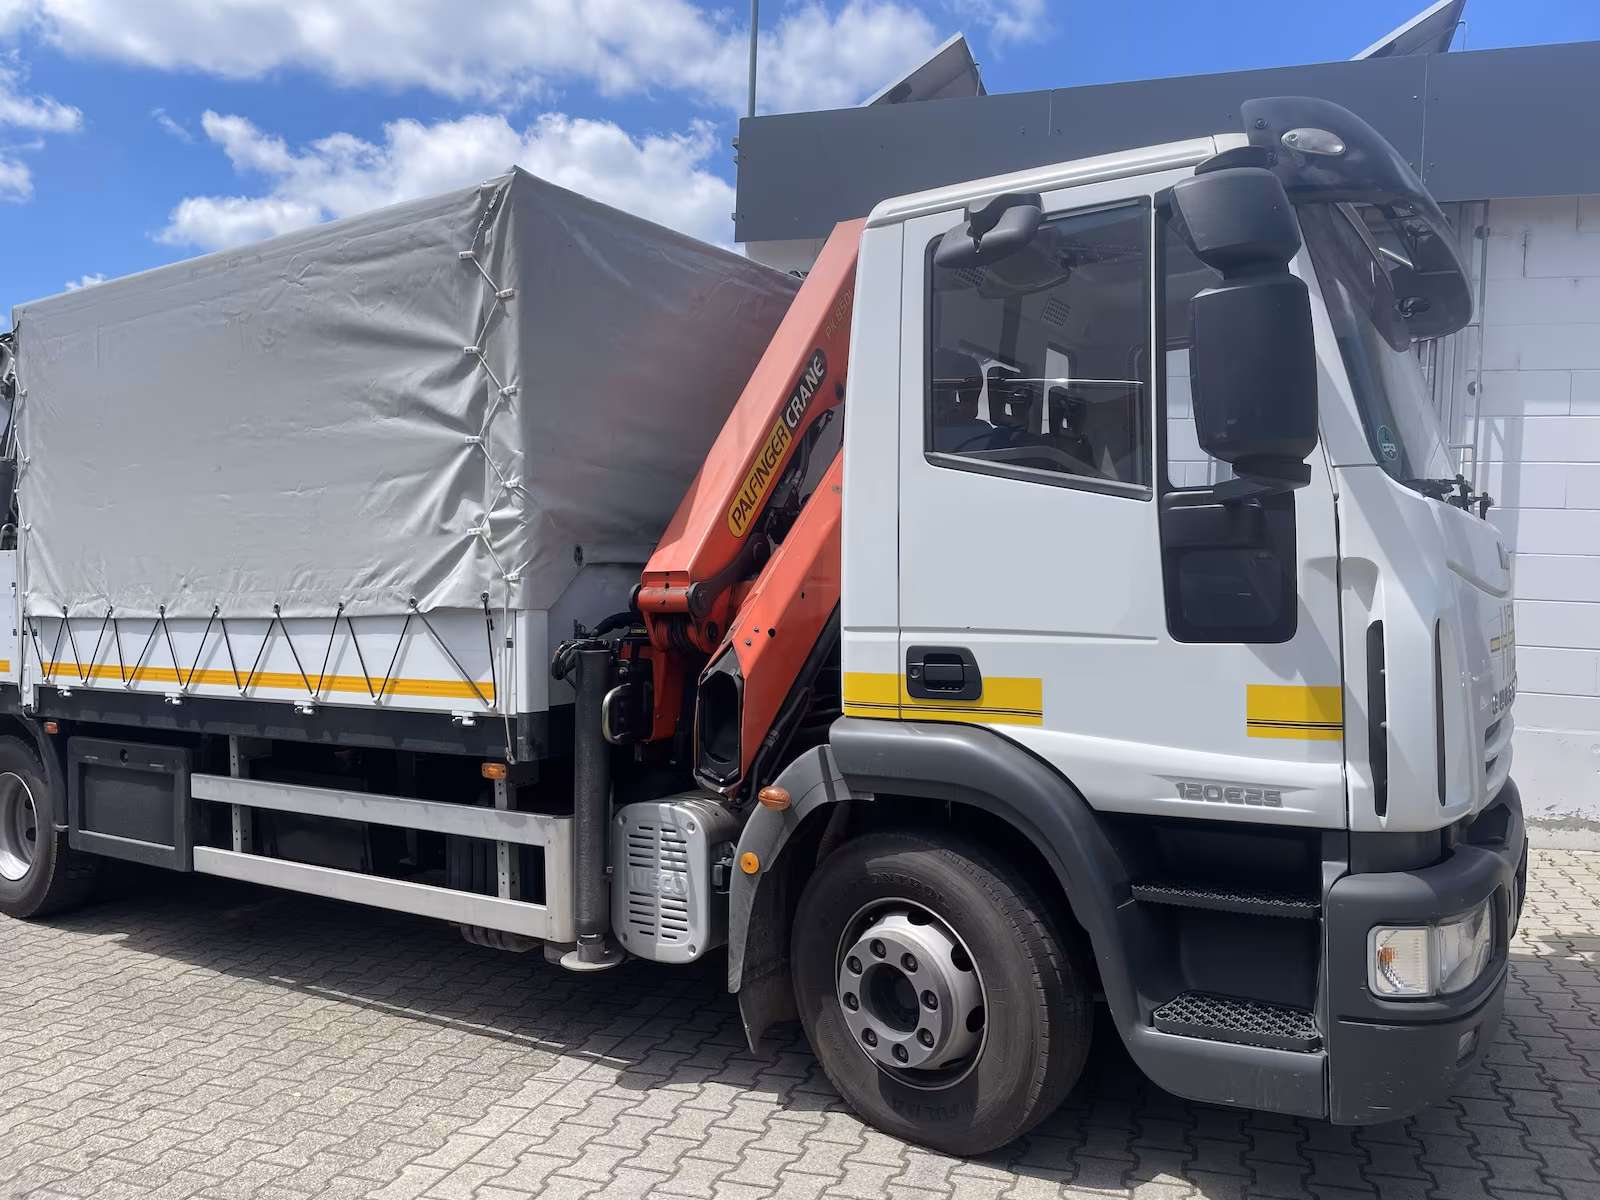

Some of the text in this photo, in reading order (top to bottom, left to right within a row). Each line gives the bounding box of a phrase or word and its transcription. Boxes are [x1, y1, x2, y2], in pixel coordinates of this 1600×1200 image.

[731, 355, 824, 531] PALFINGER CRANE
[1175, 782, 1283, 808] 120E25
